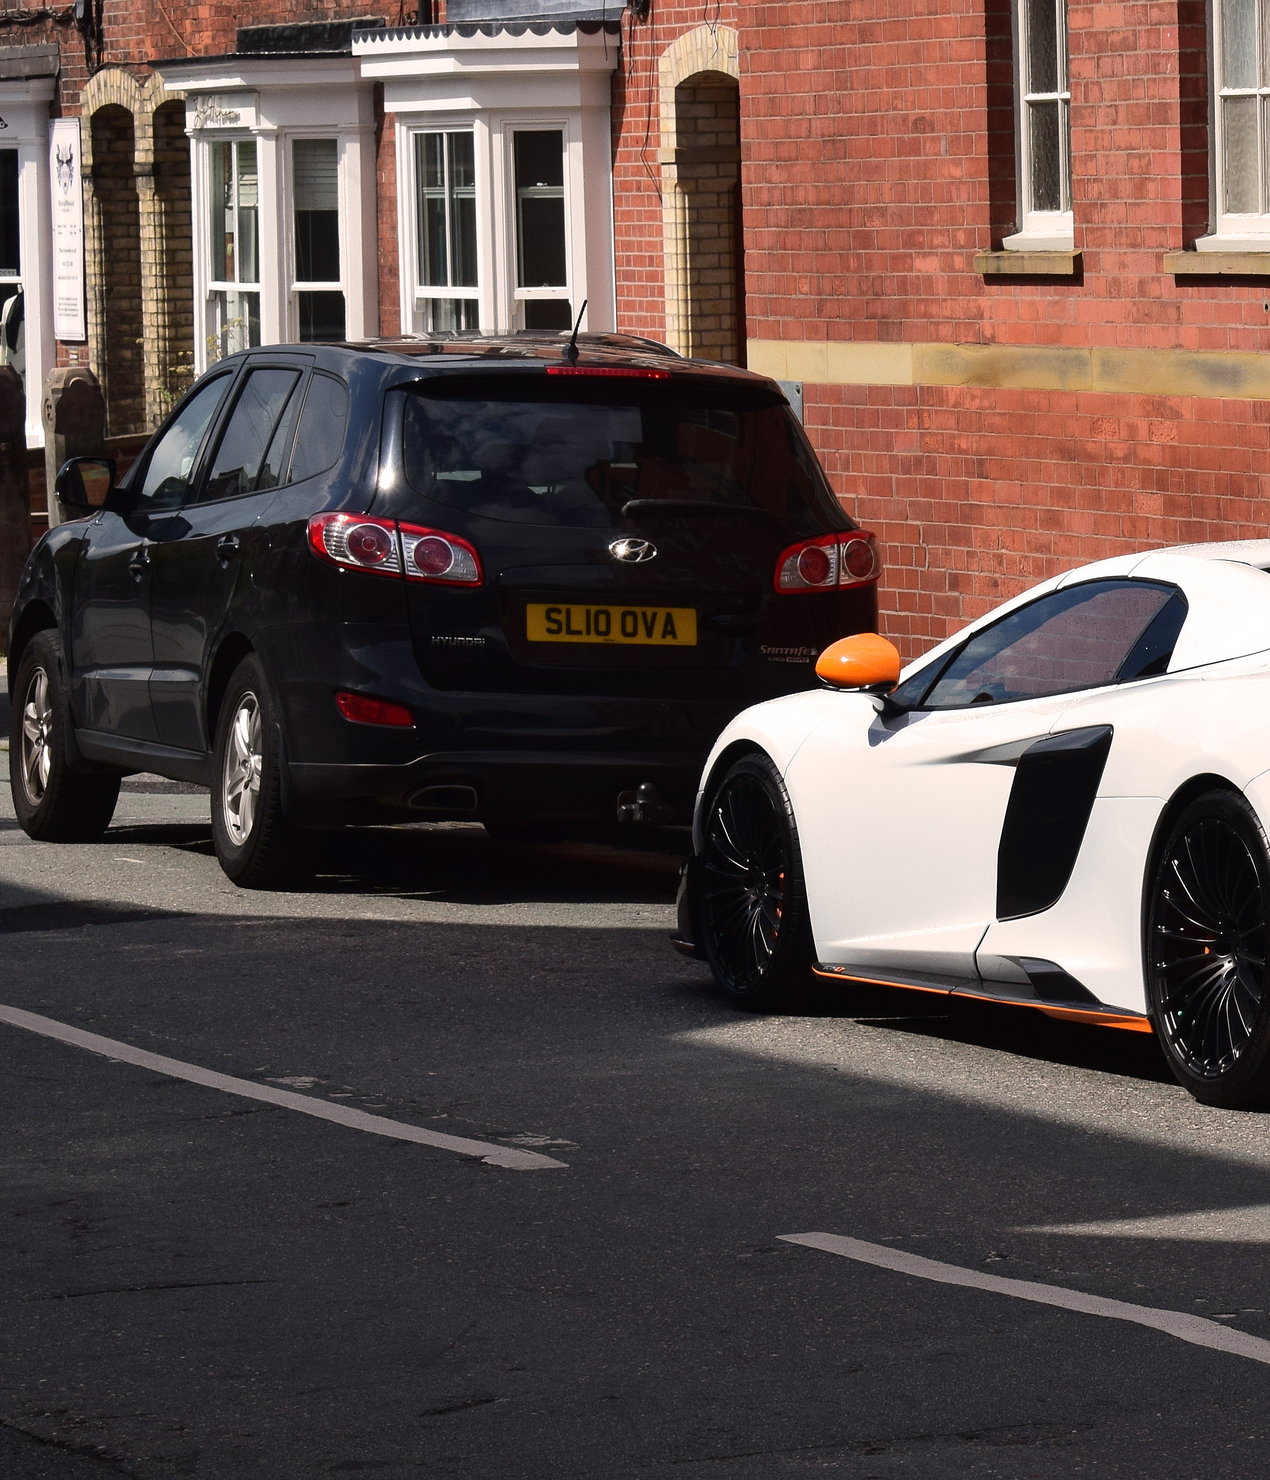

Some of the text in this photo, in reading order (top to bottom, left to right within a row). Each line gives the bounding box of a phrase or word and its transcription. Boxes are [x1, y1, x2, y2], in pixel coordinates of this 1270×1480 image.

[545, 607, 678, 640] SL10 OVA
[431, 636, 486, 646] HYUNDAI
